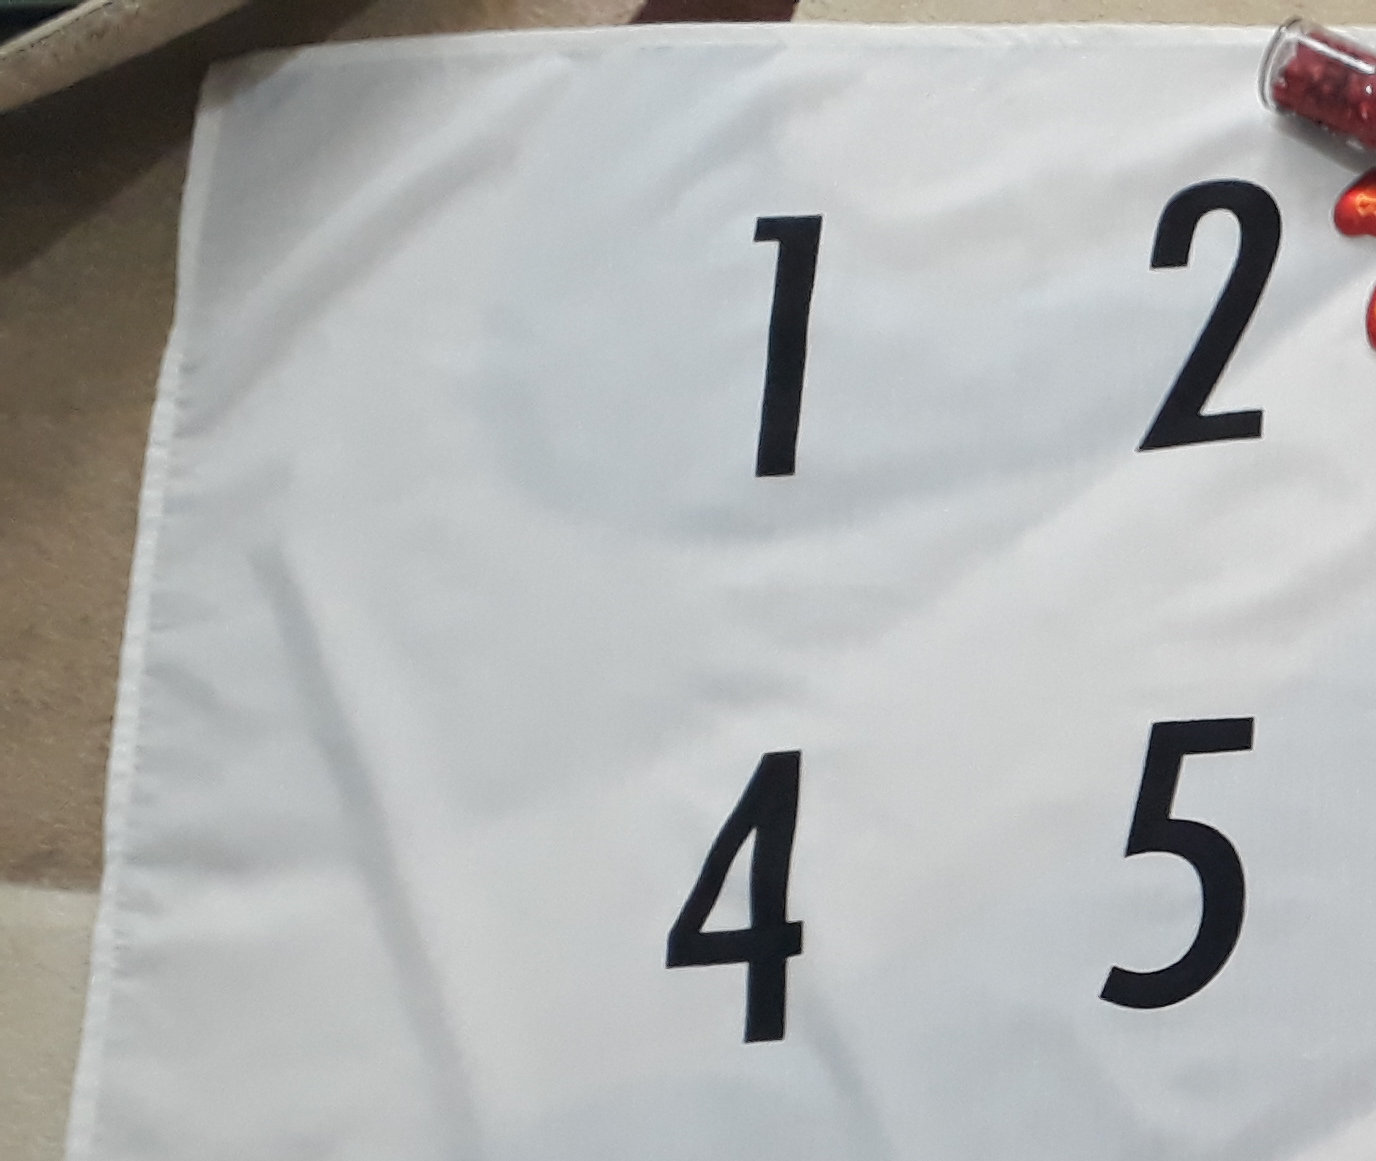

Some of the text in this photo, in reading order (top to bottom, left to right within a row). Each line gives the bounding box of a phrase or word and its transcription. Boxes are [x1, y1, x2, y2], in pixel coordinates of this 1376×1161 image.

[754, 216, 823, 477] 1
[1139, 181, 1282, 451] 2
[666, 751, 803, 1044] 4
[1100, 717, 1254, 1010] 5
